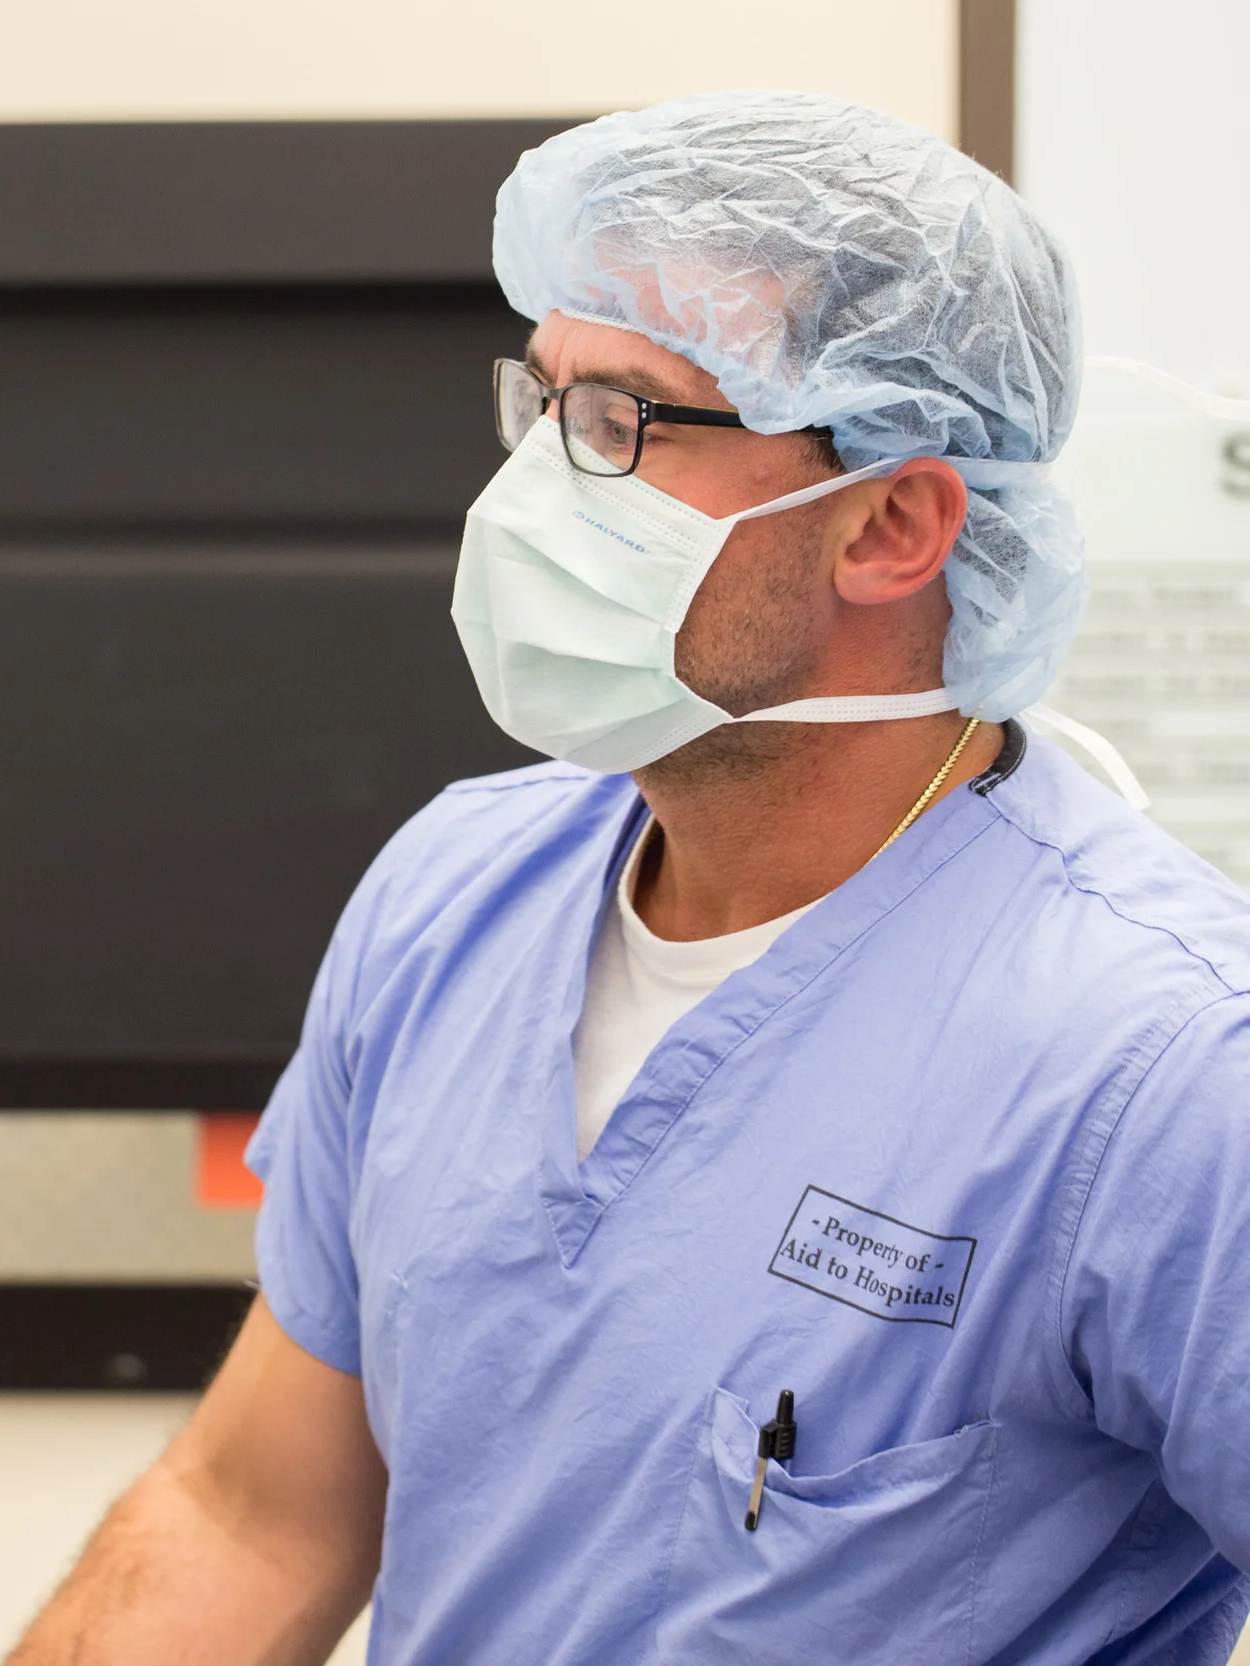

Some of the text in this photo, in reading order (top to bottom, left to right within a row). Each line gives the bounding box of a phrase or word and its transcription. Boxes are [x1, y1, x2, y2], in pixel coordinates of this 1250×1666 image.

[780, 1238, 955, 1308] Aid to Hospitals
[822, 1216, 903, 1268] Property
[905, 1253, 931, 1273] of
